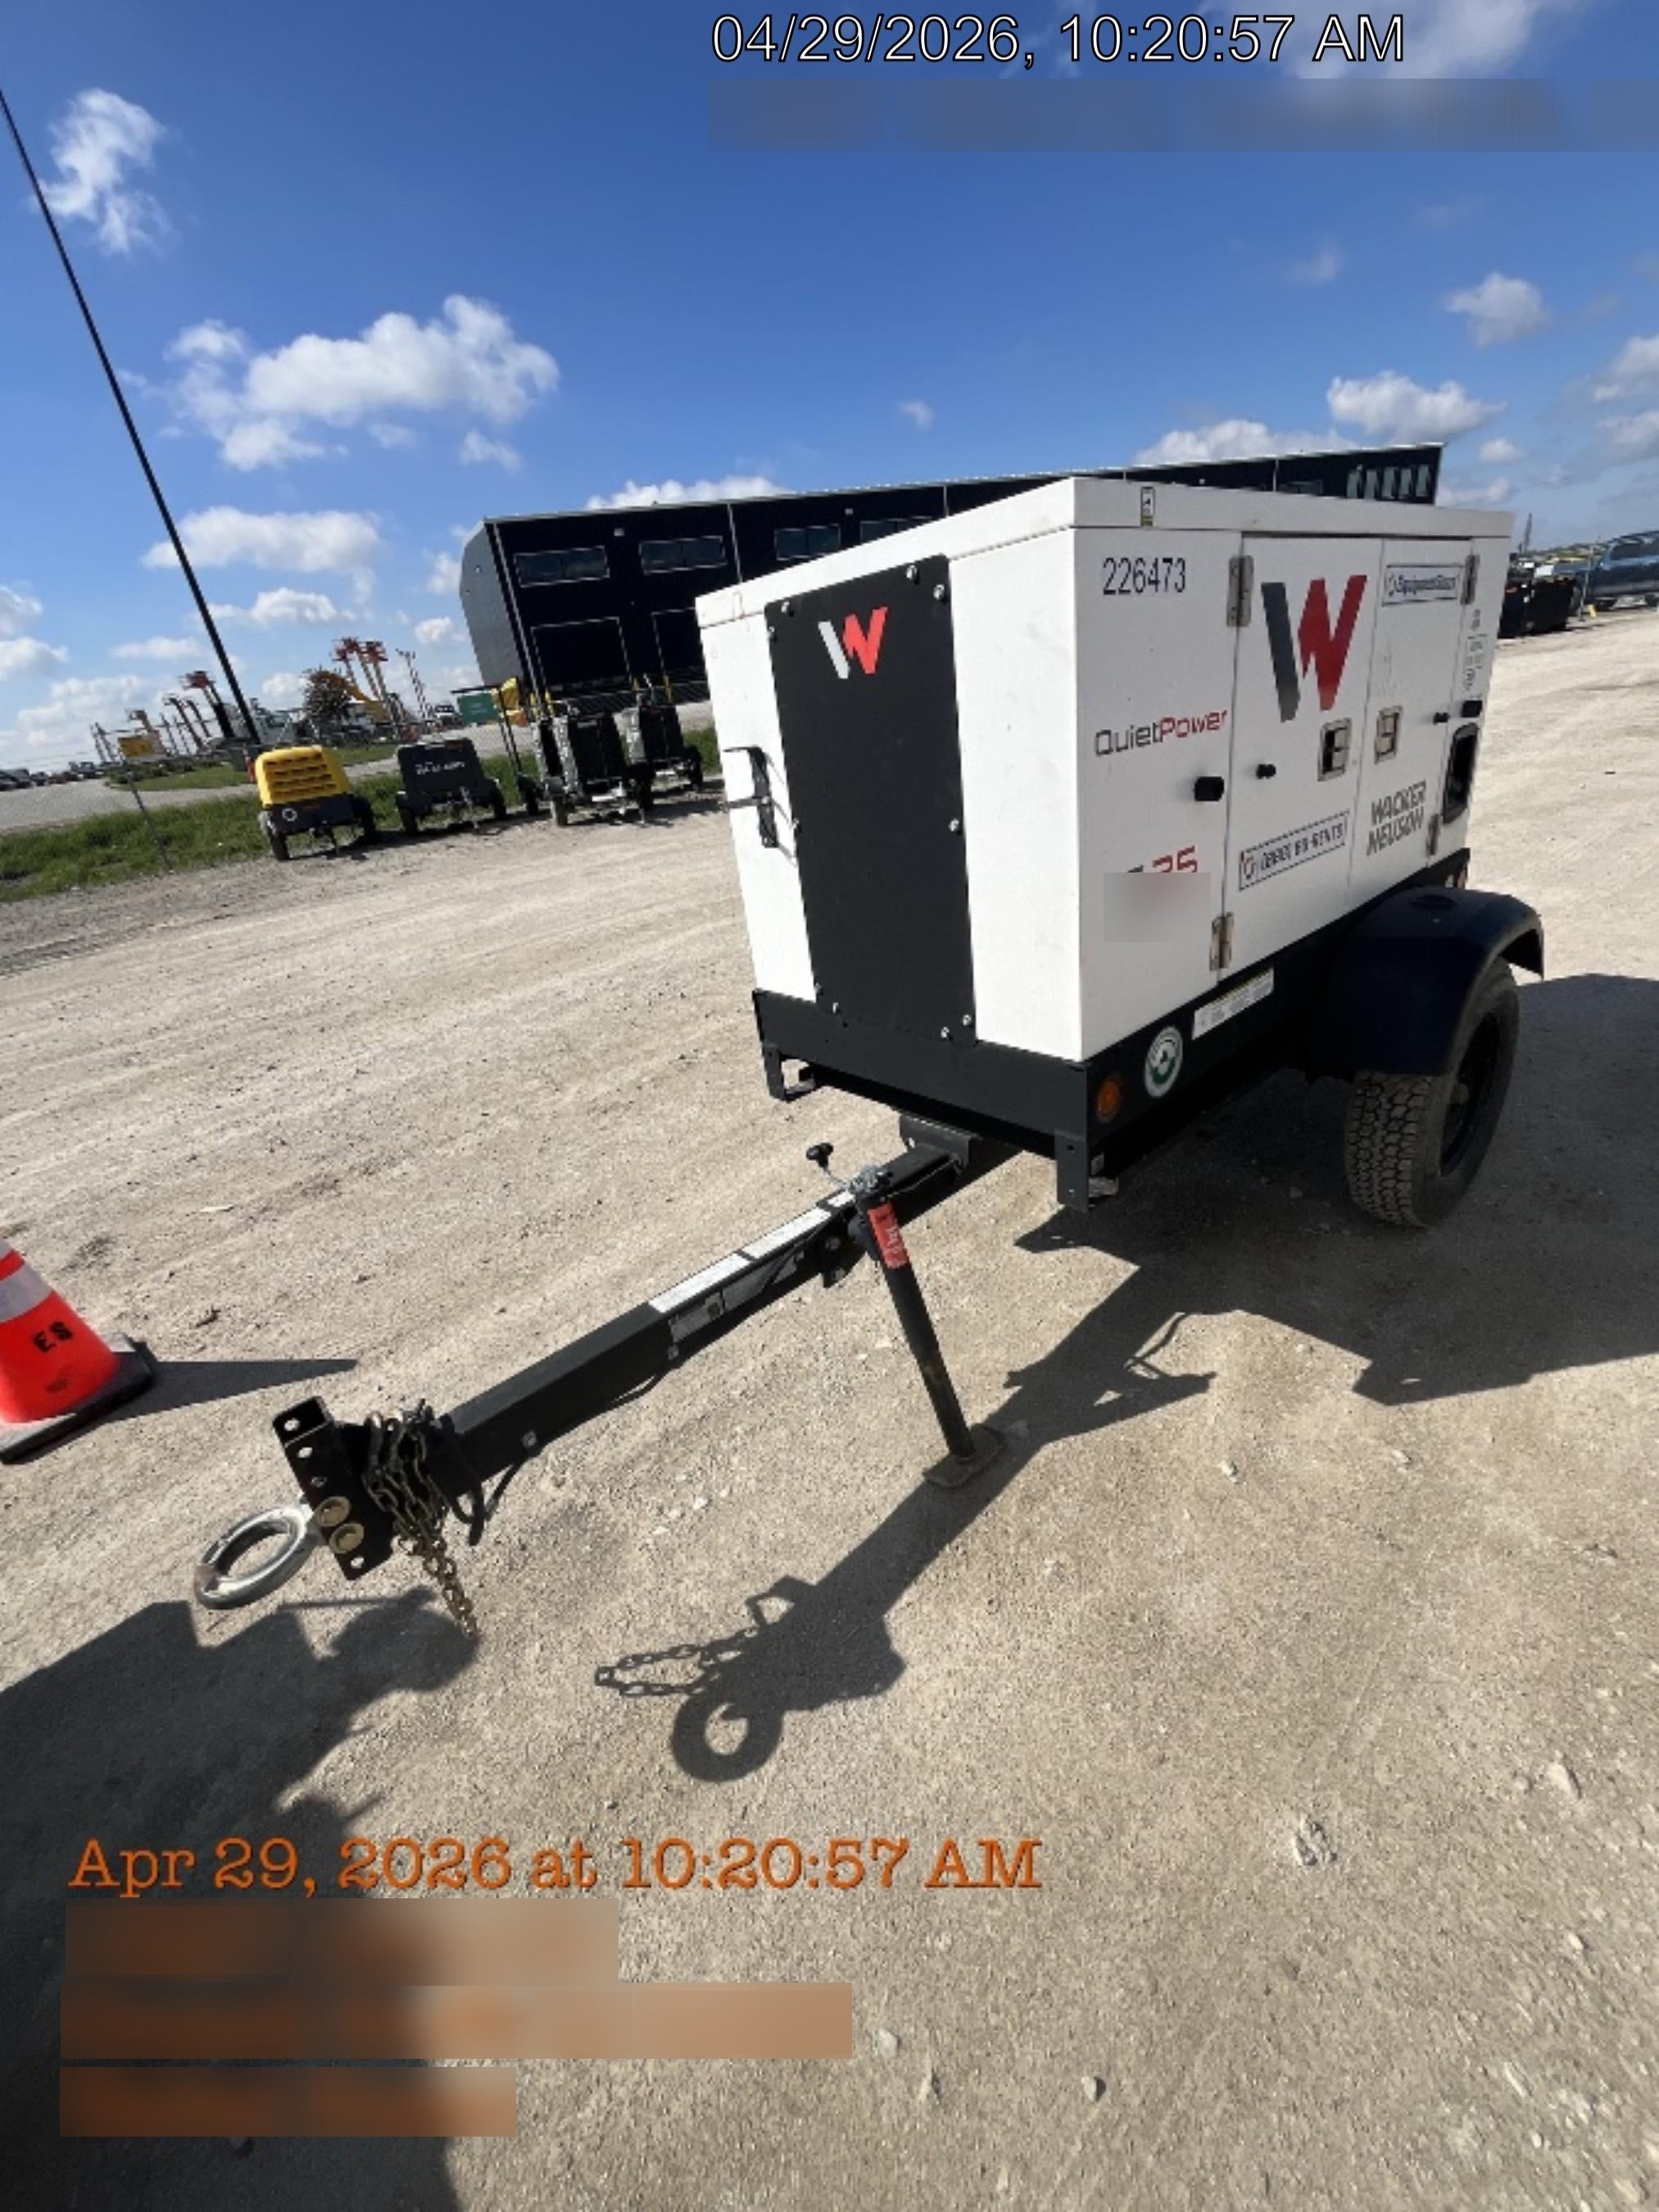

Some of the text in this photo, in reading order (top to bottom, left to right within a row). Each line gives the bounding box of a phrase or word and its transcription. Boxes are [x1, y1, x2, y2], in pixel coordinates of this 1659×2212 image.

[1103, 557, 1186, 595] 226473
[1095, 709, 1227, 757] QuietPower
[1371, 780, 1426, 826] WACKER
